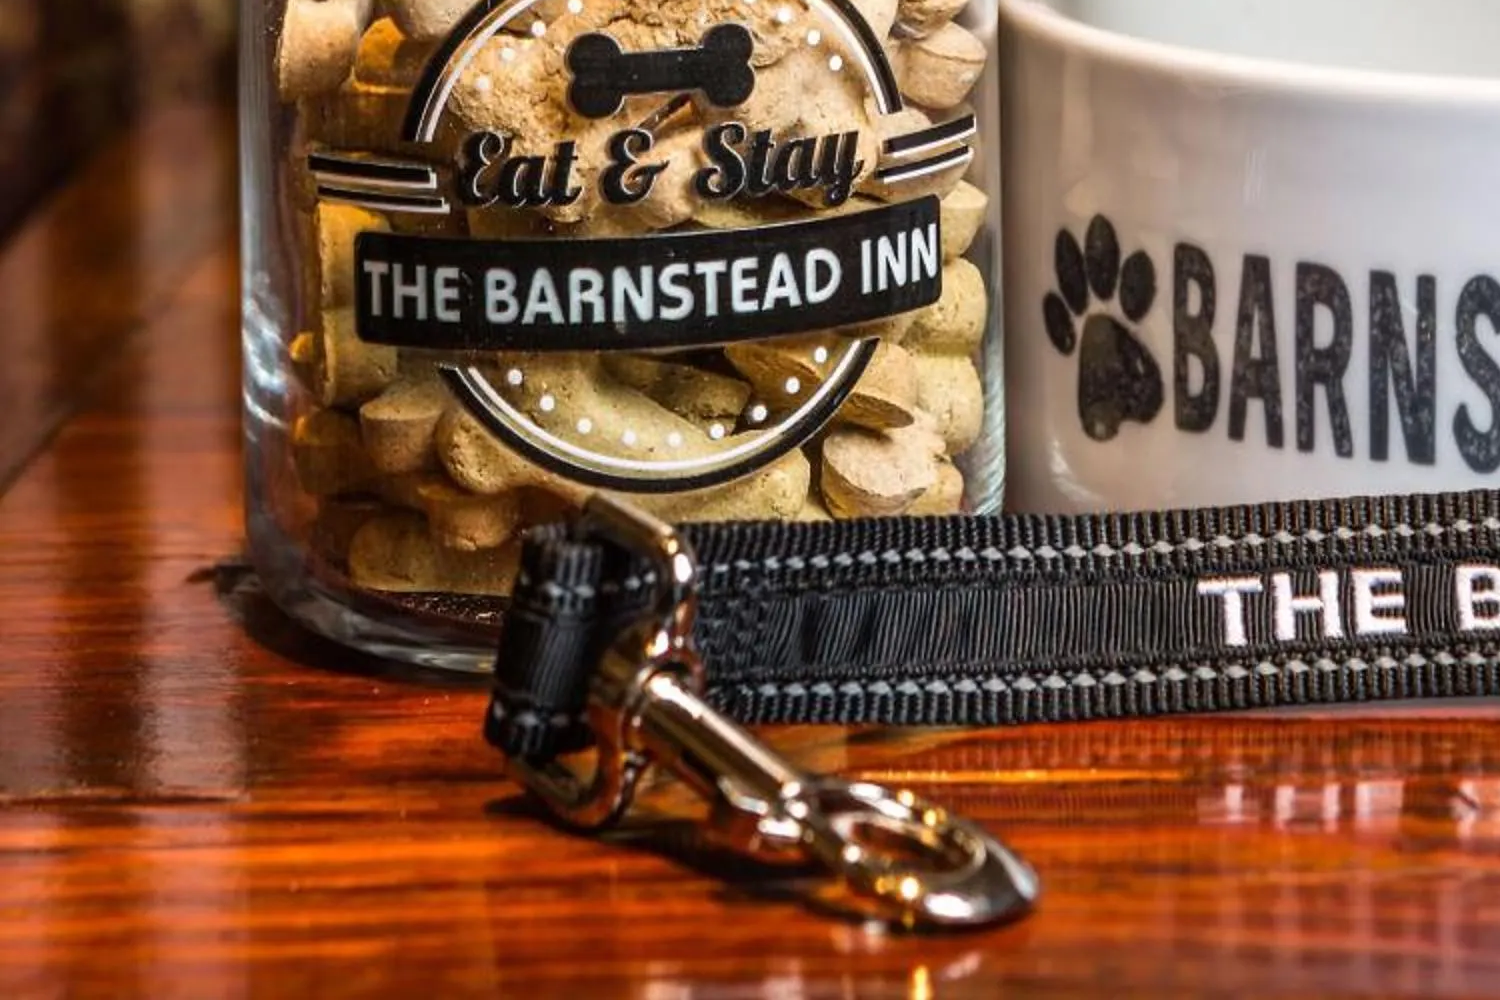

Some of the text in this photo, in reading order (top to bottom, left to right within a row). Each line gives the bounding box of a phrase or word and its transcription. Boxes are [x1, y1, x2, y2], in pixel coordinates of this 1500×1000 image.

[457, 121, 863, 208] Eat & Stay
[363, 222, 939, 326] THE BARNSTEAD INN
[1198, 569, 1406, 647] THE
